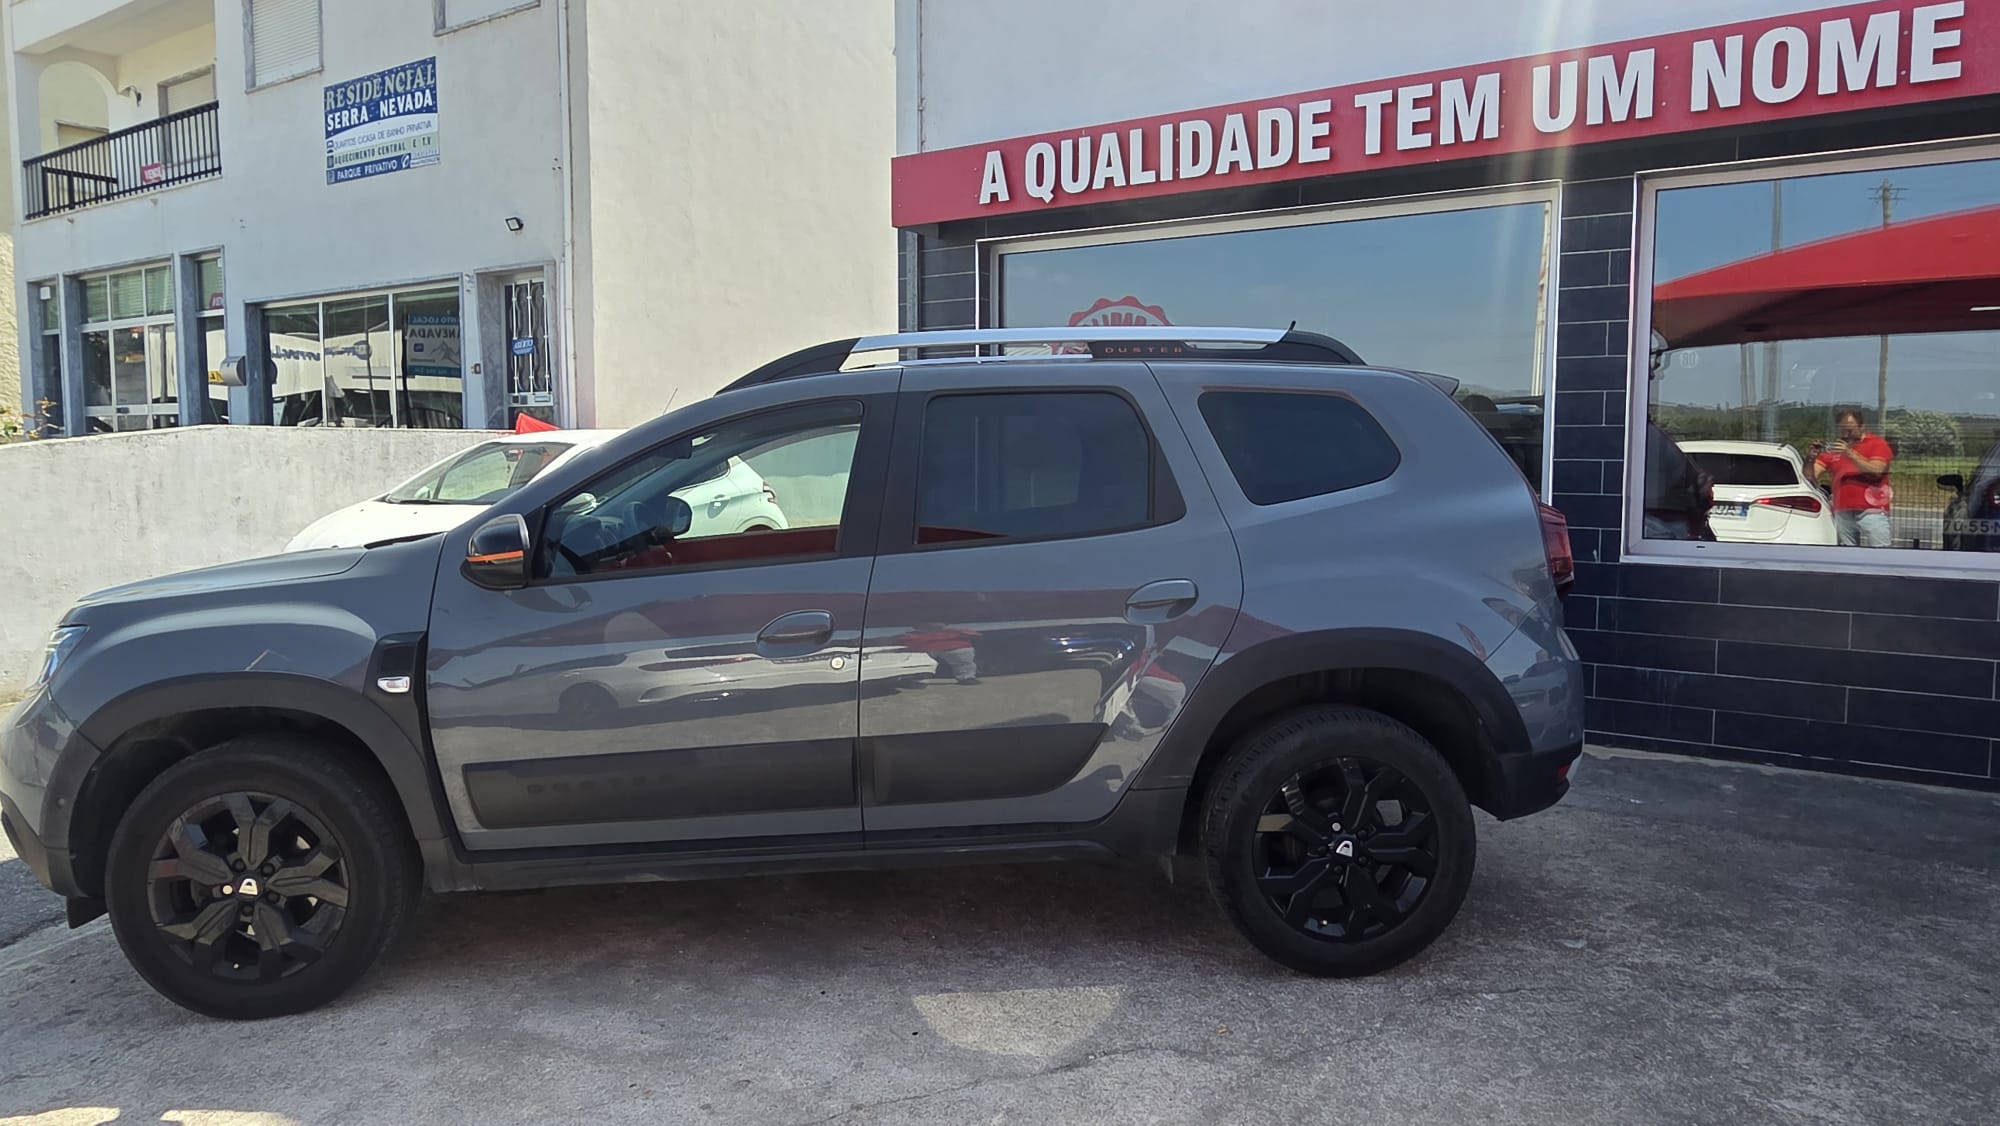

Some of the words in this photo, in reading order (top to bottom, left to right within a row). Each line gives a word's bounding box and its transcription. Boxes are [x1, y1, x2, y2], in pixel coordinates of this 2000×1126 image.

[327, 105, 369, 131] SERRA
[380, 89, 433, 118] NEVADA
[980, 150, 1010, 204] A
[1025, 99, 1332, 203] QUALIDADE
[1354, 73, 1502, 155] TEM
[1532, 48, 1657, 133] UM
[1690, 0, 1966, 112] NOME
[378, 141, 406, 156] CENTRAL
[337, 166, 361, 180] PARQUE
[365, 158, 398, 174] PRIVATIVO
[1104, 346, 1183, 354] DUSTER
